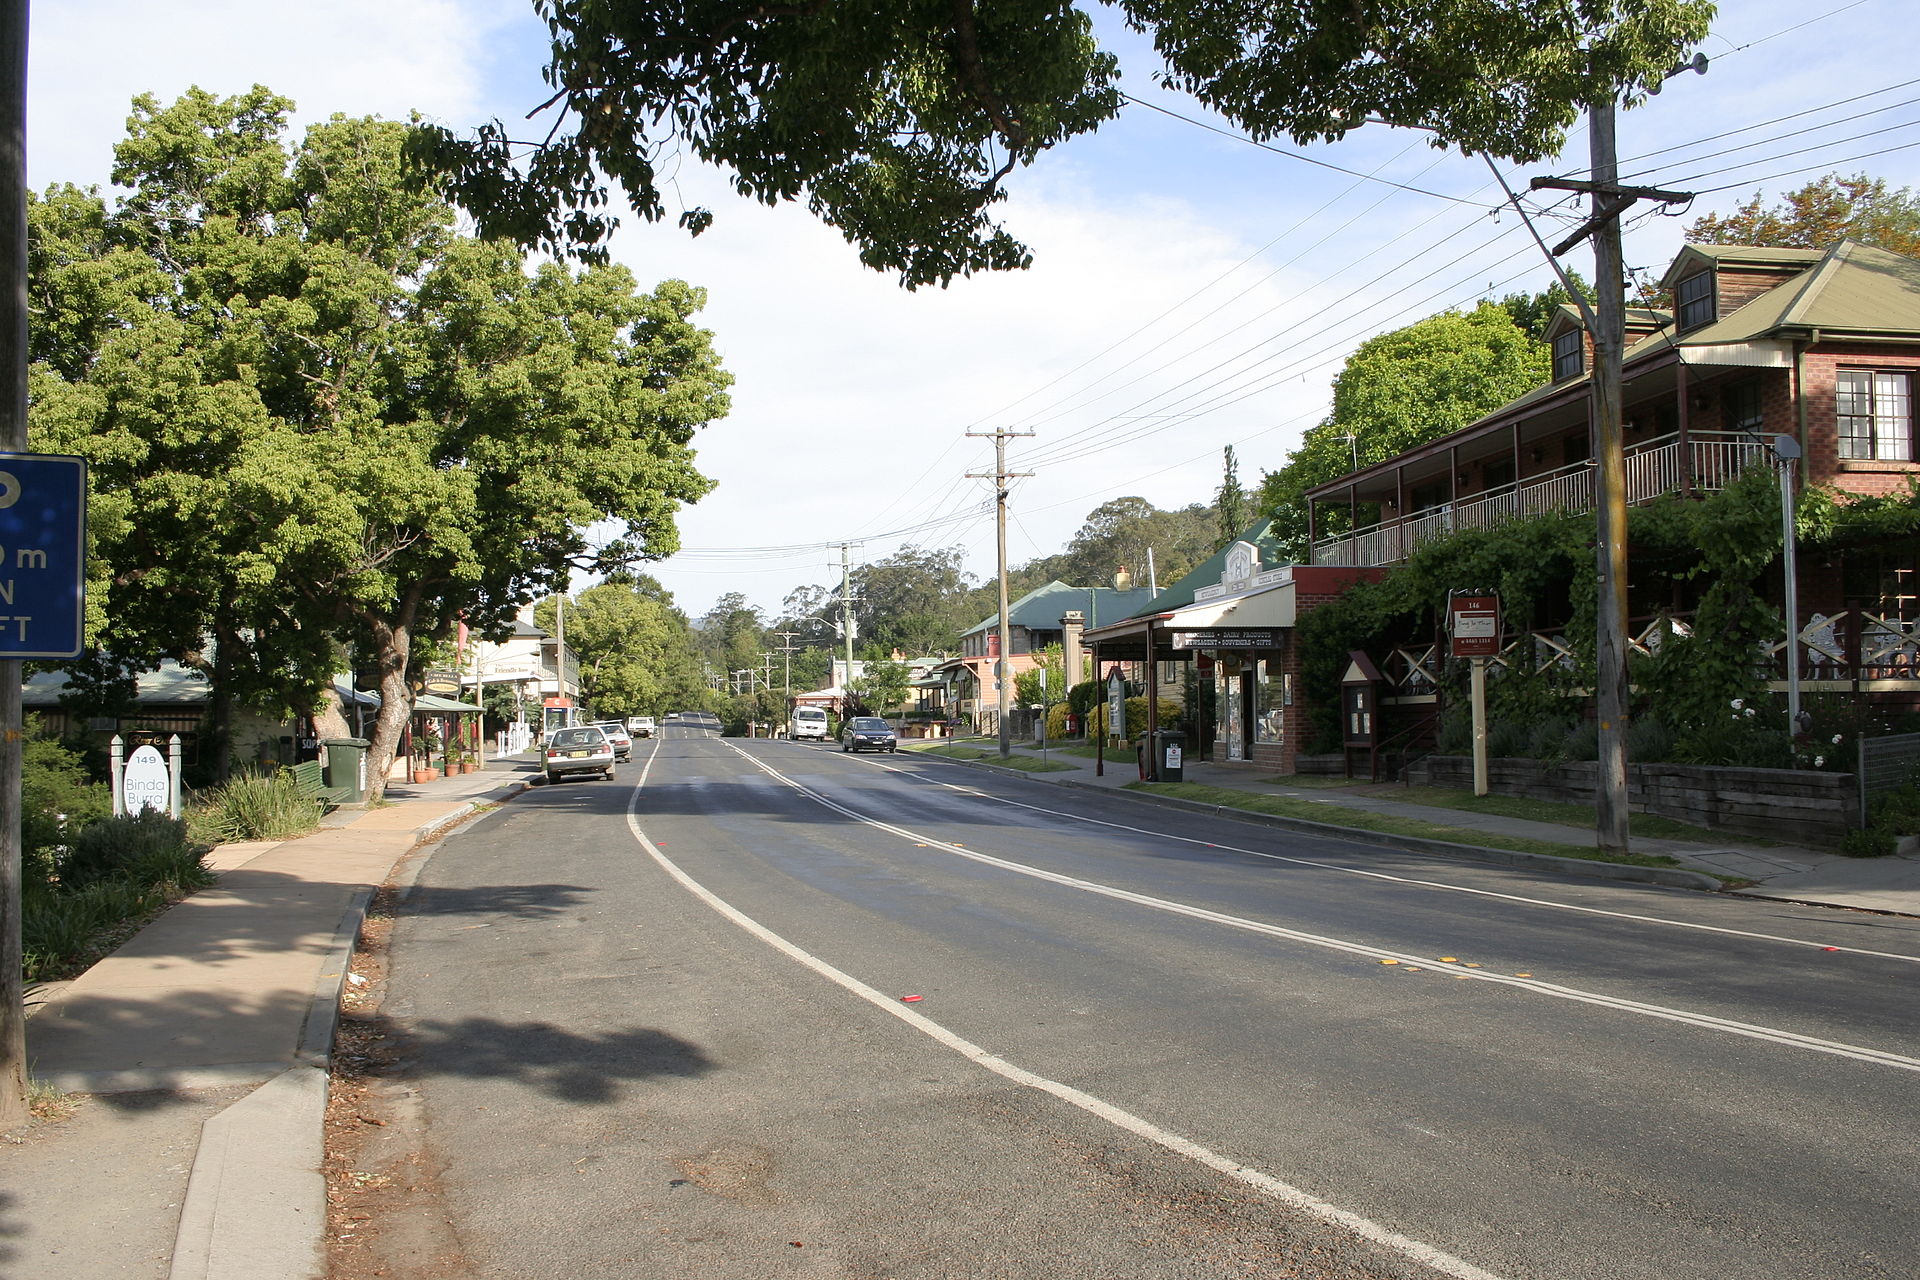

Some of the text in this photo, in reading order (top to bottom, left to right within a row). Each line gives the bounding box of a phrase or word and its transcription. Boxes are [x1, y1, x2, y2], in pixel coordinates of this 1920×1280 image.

[136, 756, 156, 764] 149
[126, 778, 165, 791] Binda
[128, 792, 163, 805] Burra
